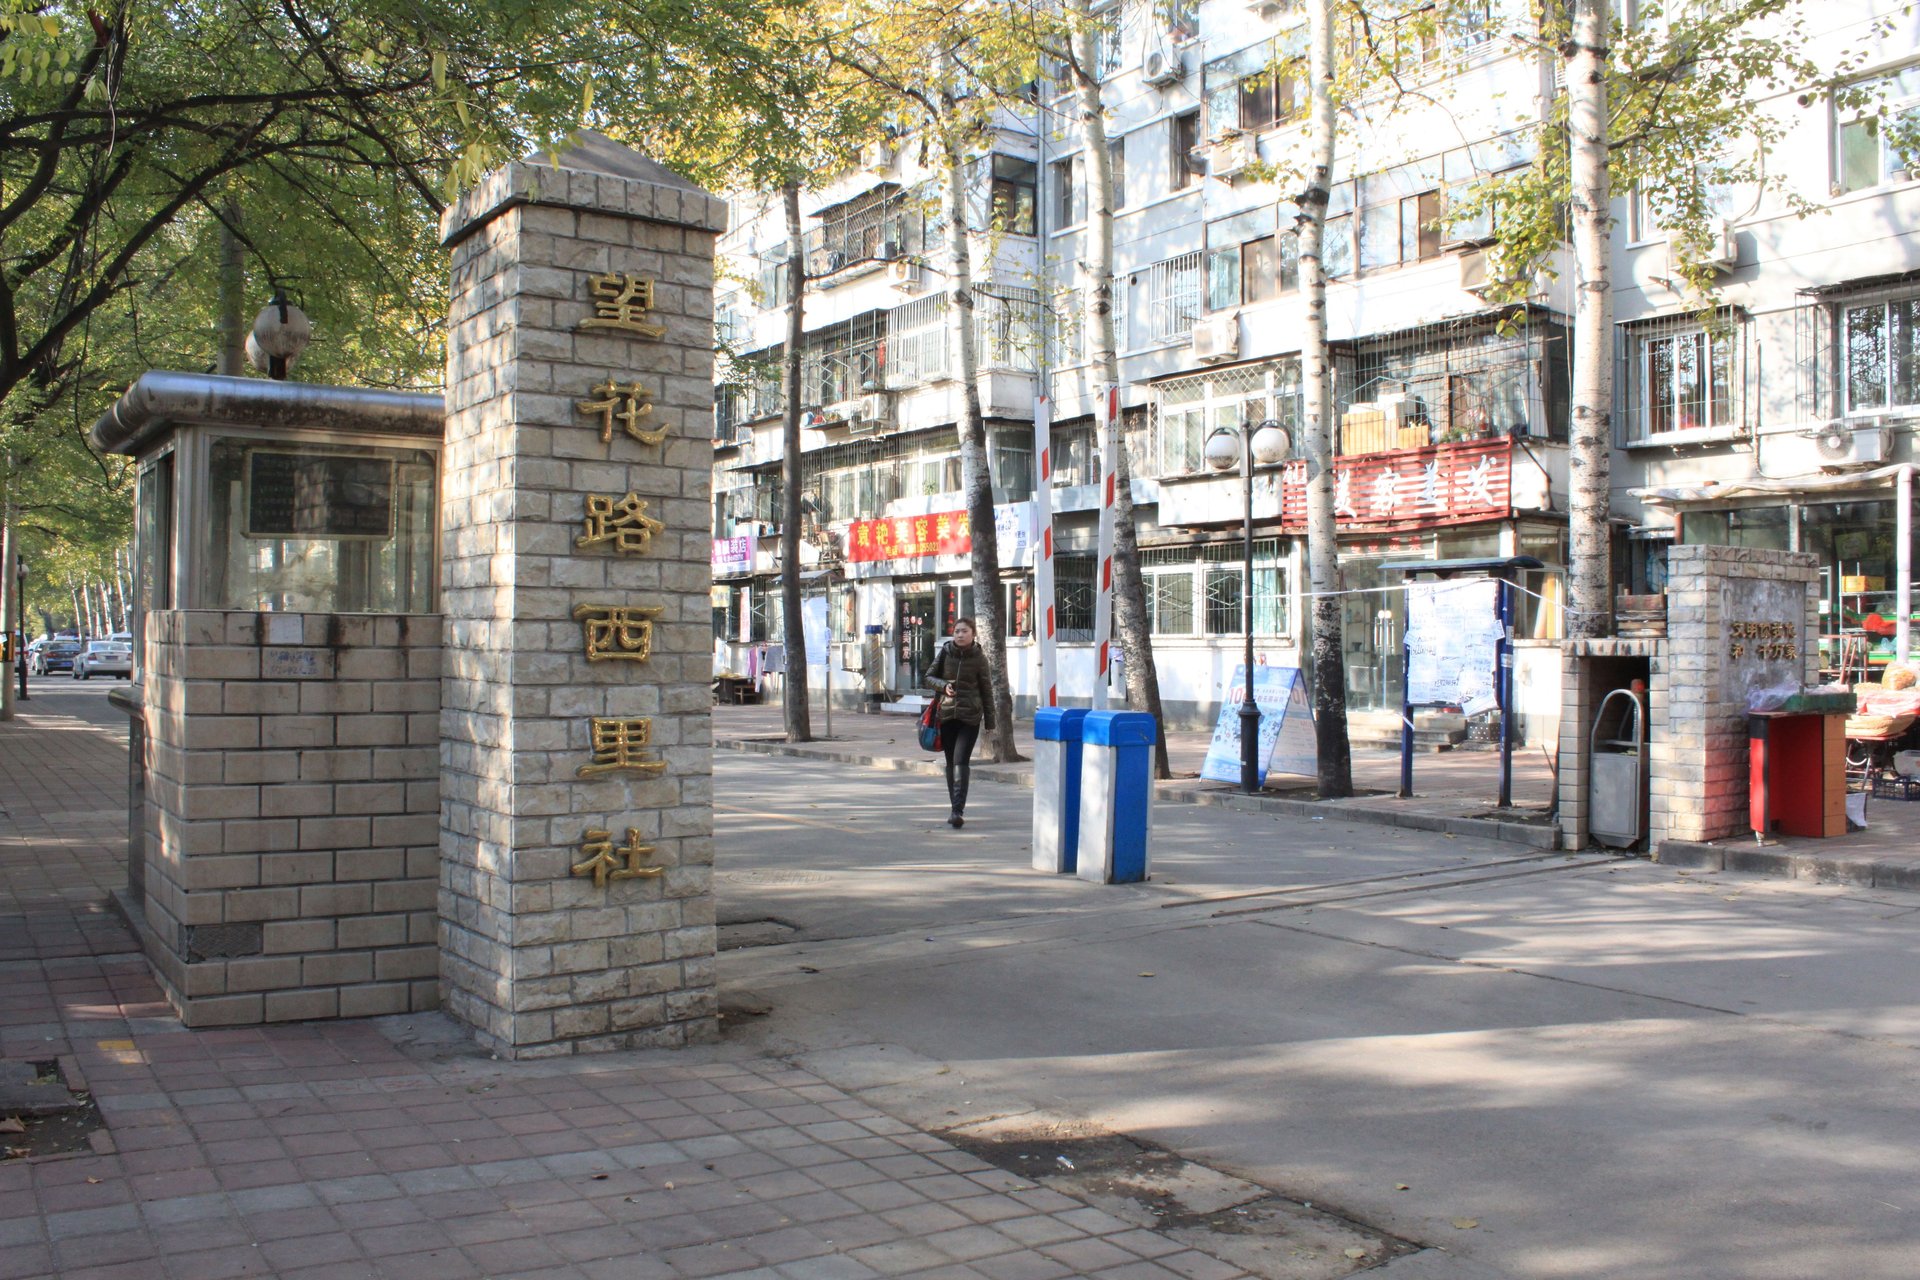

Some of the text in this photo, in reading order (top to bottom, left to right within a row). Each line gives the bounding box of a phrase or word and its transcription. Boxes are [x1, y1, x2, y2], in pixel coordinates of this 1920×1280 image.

[571, 272, 668, 888] 望花路西里社
